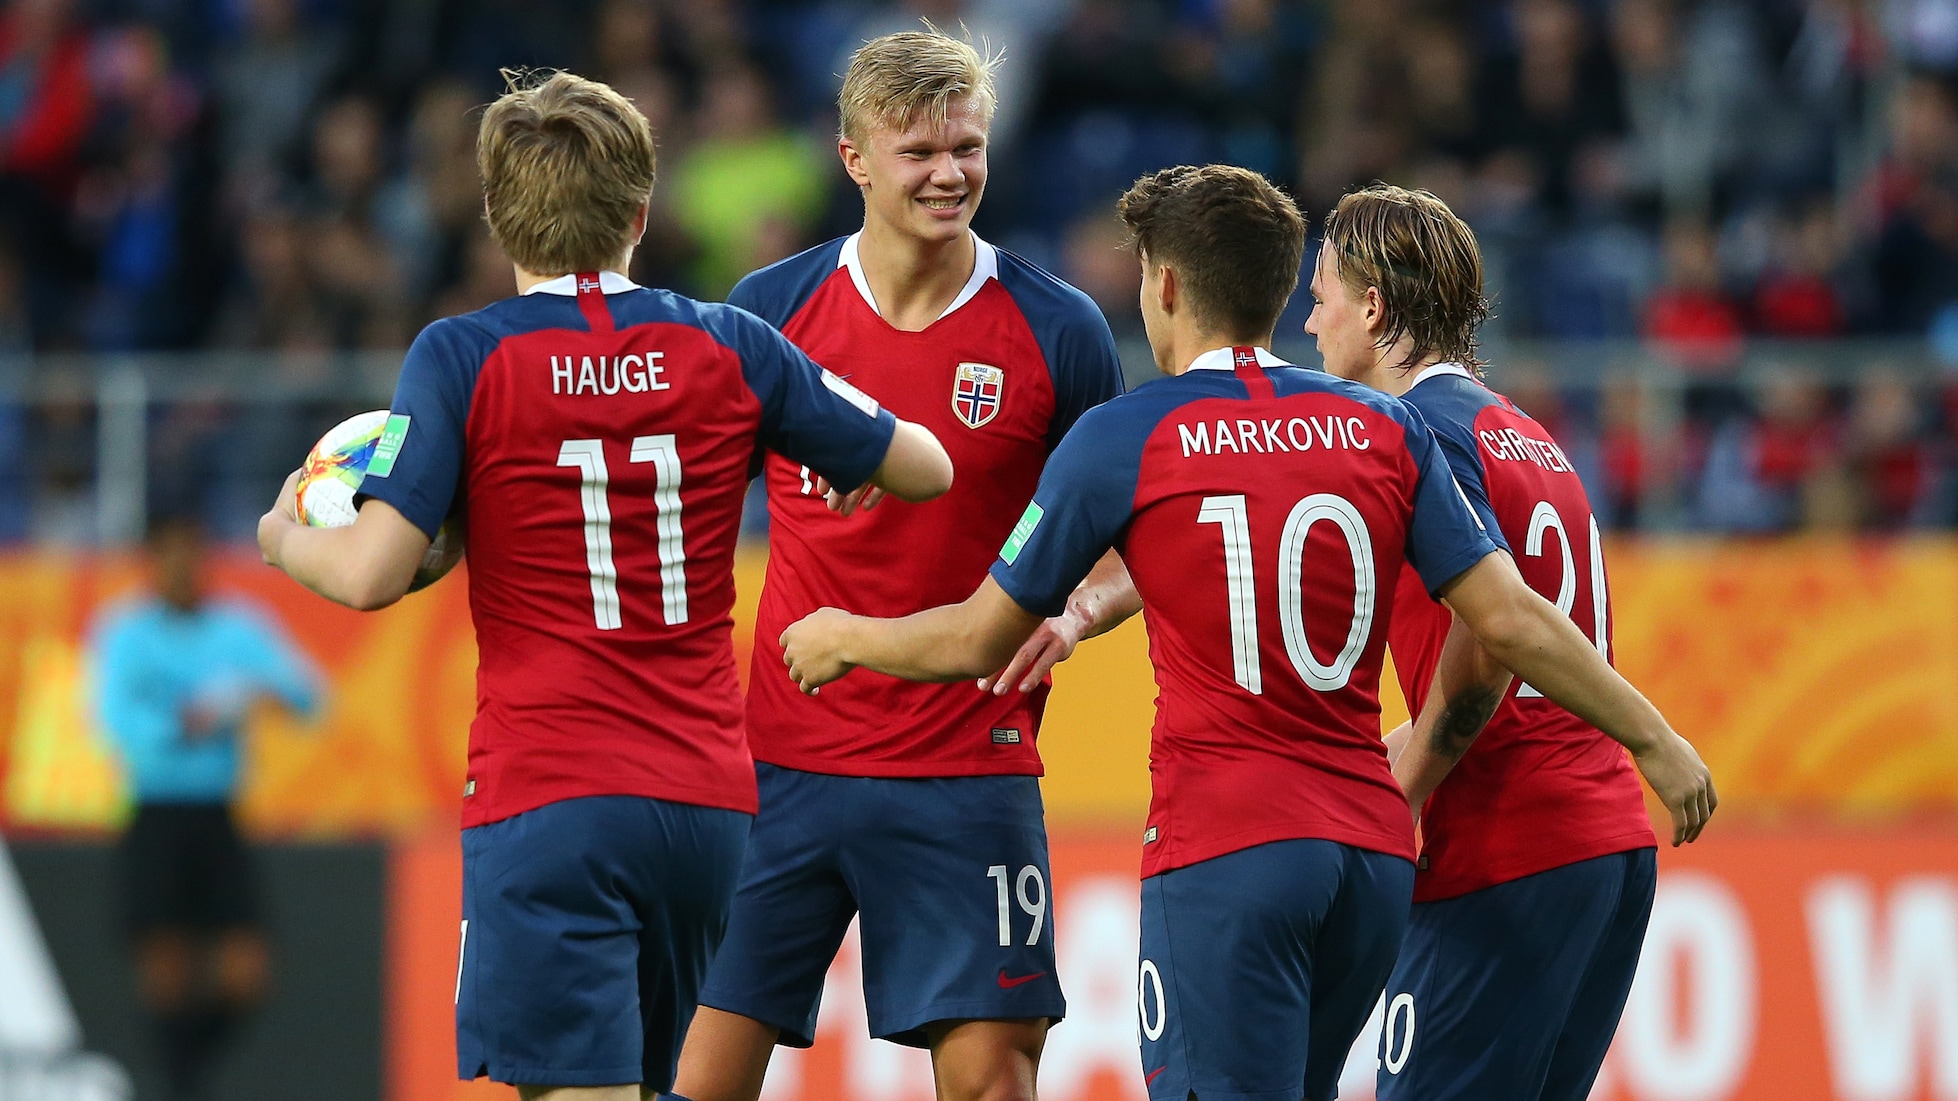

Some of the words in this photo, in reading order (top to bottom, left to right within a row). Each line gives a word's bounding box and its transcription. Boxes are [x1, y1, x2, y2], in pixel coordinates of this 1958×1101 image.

[551, 351, 670, 396] HAUGE
[1178, 415, 1371, 457] MARKOVIC
[556, 434, 689, 630] 11
[1196, 493, 1377, 696] 10
[986, 864, 1046, 946] 19
